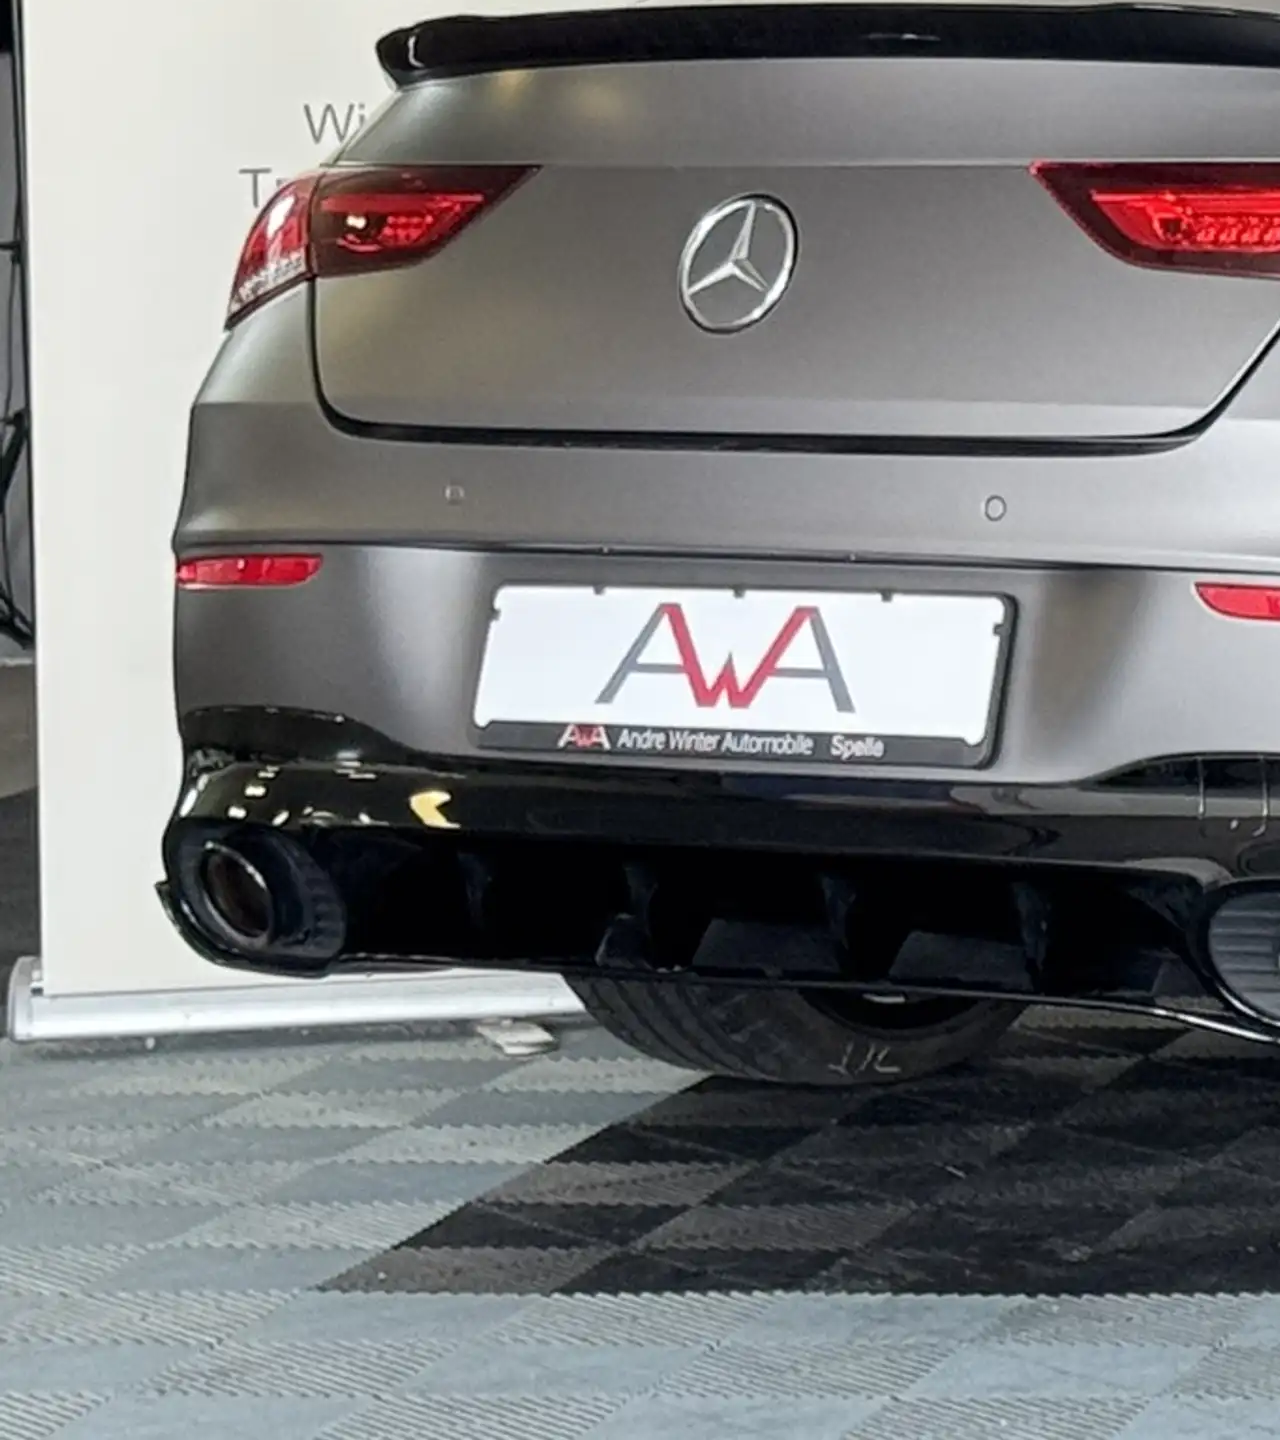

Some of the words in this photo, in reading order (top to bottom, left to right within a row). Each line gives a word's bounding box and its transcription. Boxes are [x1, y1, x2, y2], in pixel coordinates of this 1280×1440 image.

[595, 602, 857, 713] AWA
[616, 727, 665, 750] Andre
[668, 730, 721, 752] Winter
[721, 731, 814, 756] Automobile
[831, 734, 885, 760] Spelle
